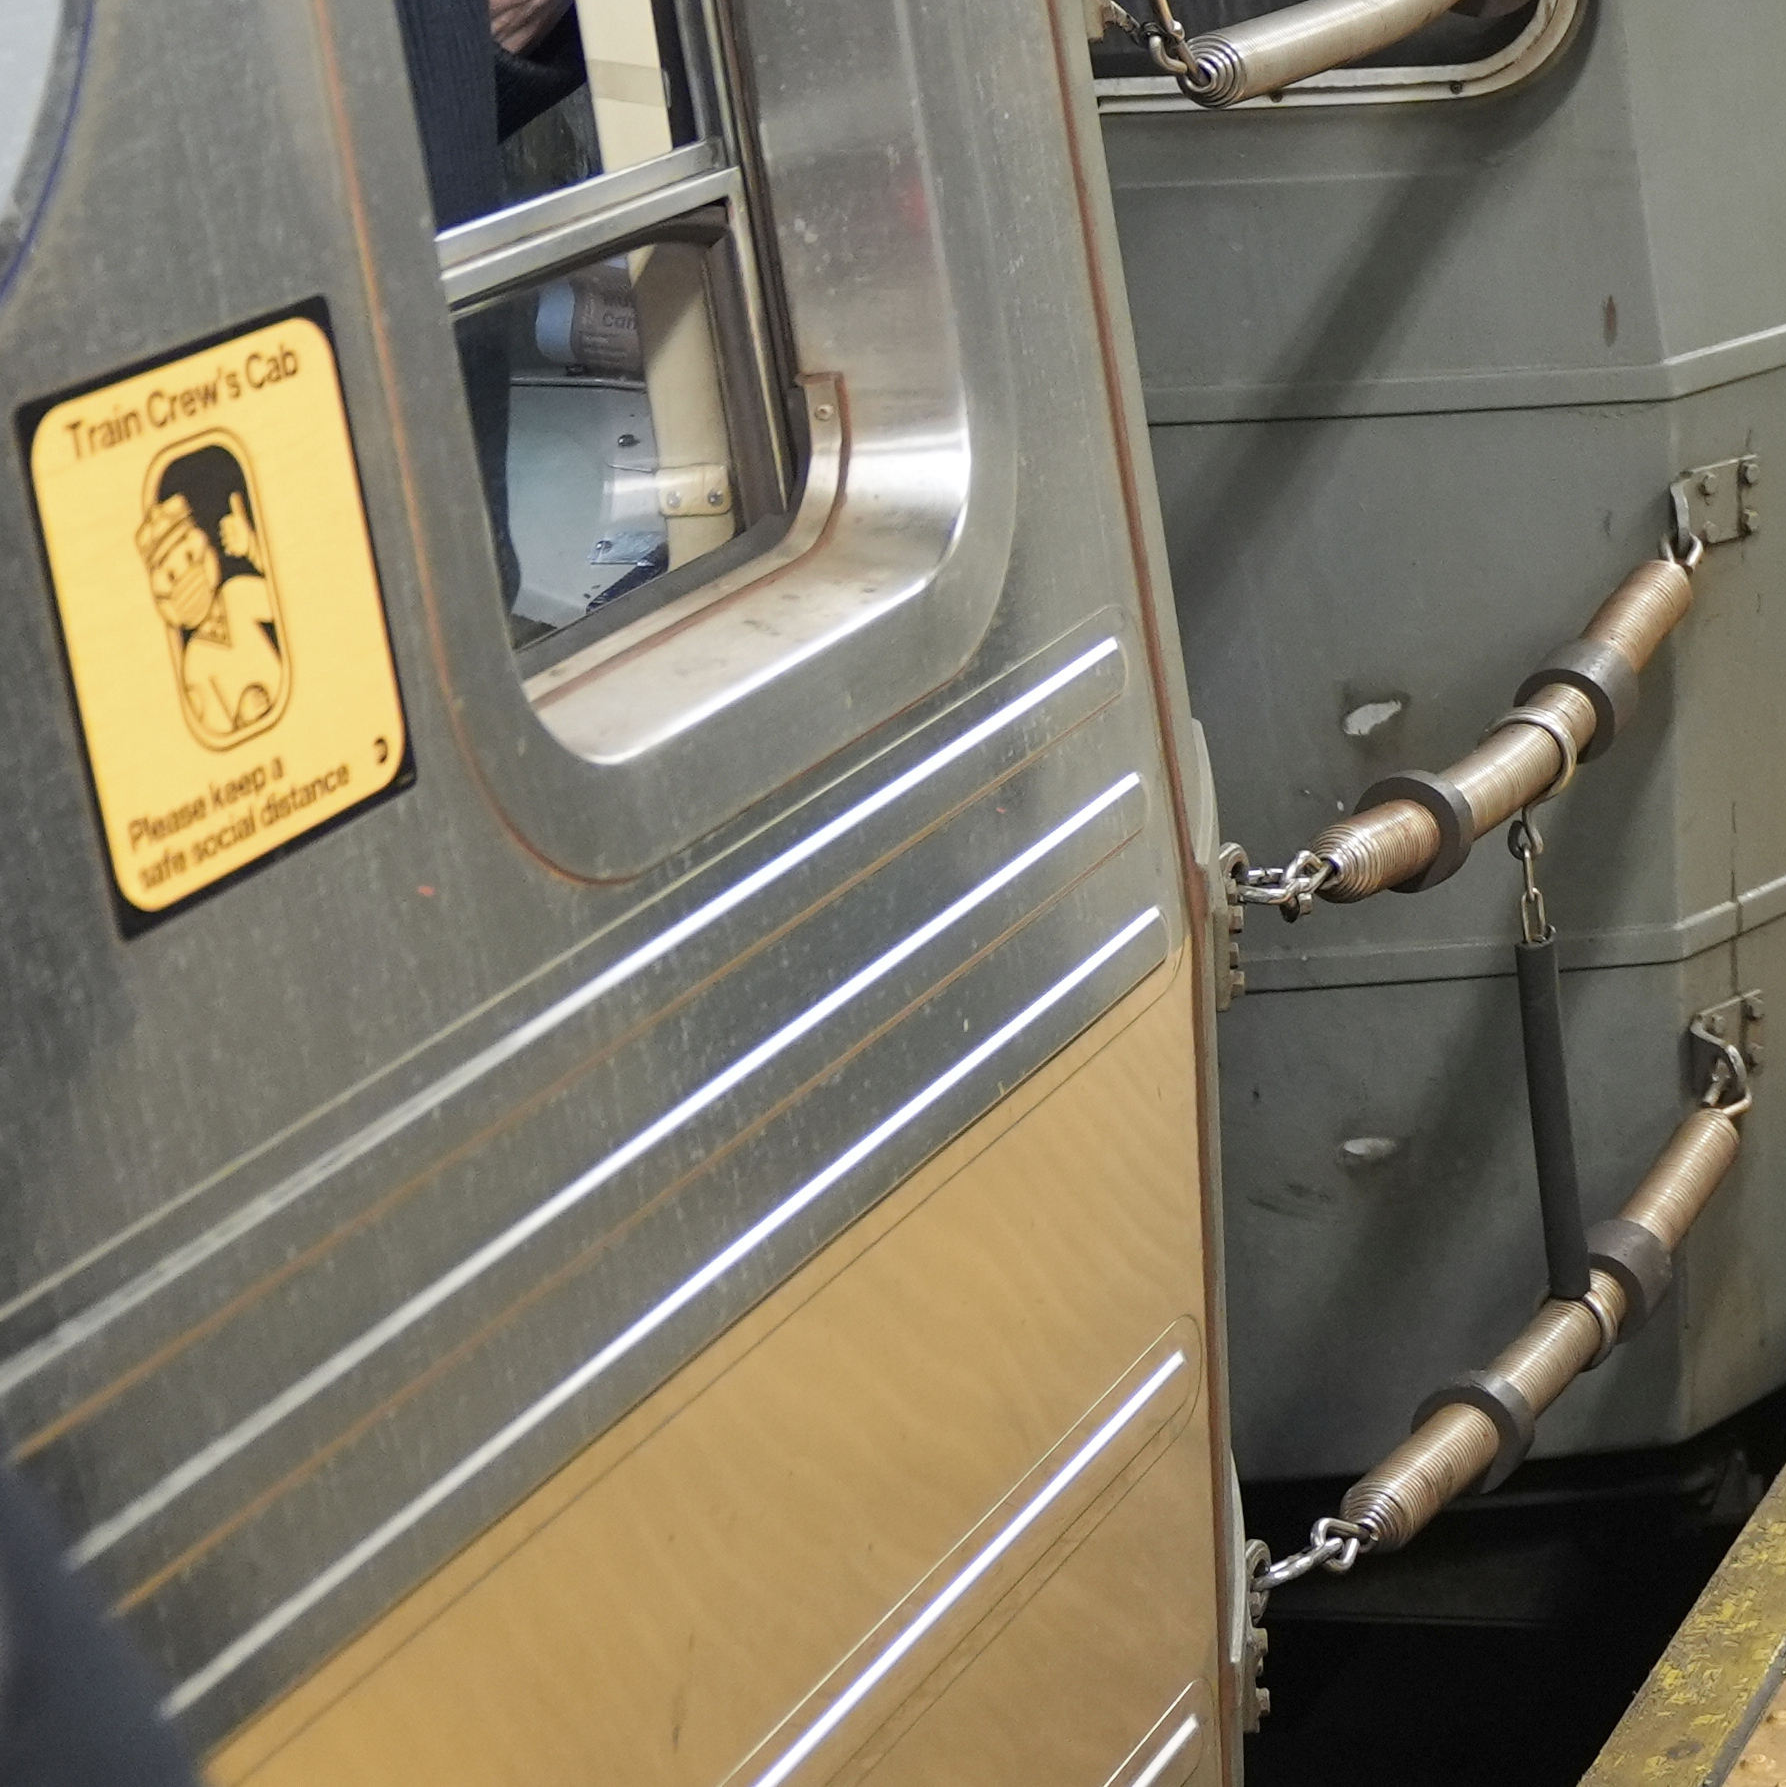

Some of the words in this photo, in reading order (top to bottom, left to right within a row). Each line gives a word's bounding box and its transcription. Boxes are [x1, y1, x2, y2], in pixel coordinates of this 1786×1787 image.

[63, 404, 143, 460] Train
[146, 366, 242, 429] Crew's
[245, 342, 299, 390] Cab
[127, 796, 207, 853] Please
[209, 764, 267, 808] keep
[271, 755, 284, 780] a
[137, 846, 188, 891] safe
[190, 804, 257, 865] social
[260, 762, 351, 828] distance
